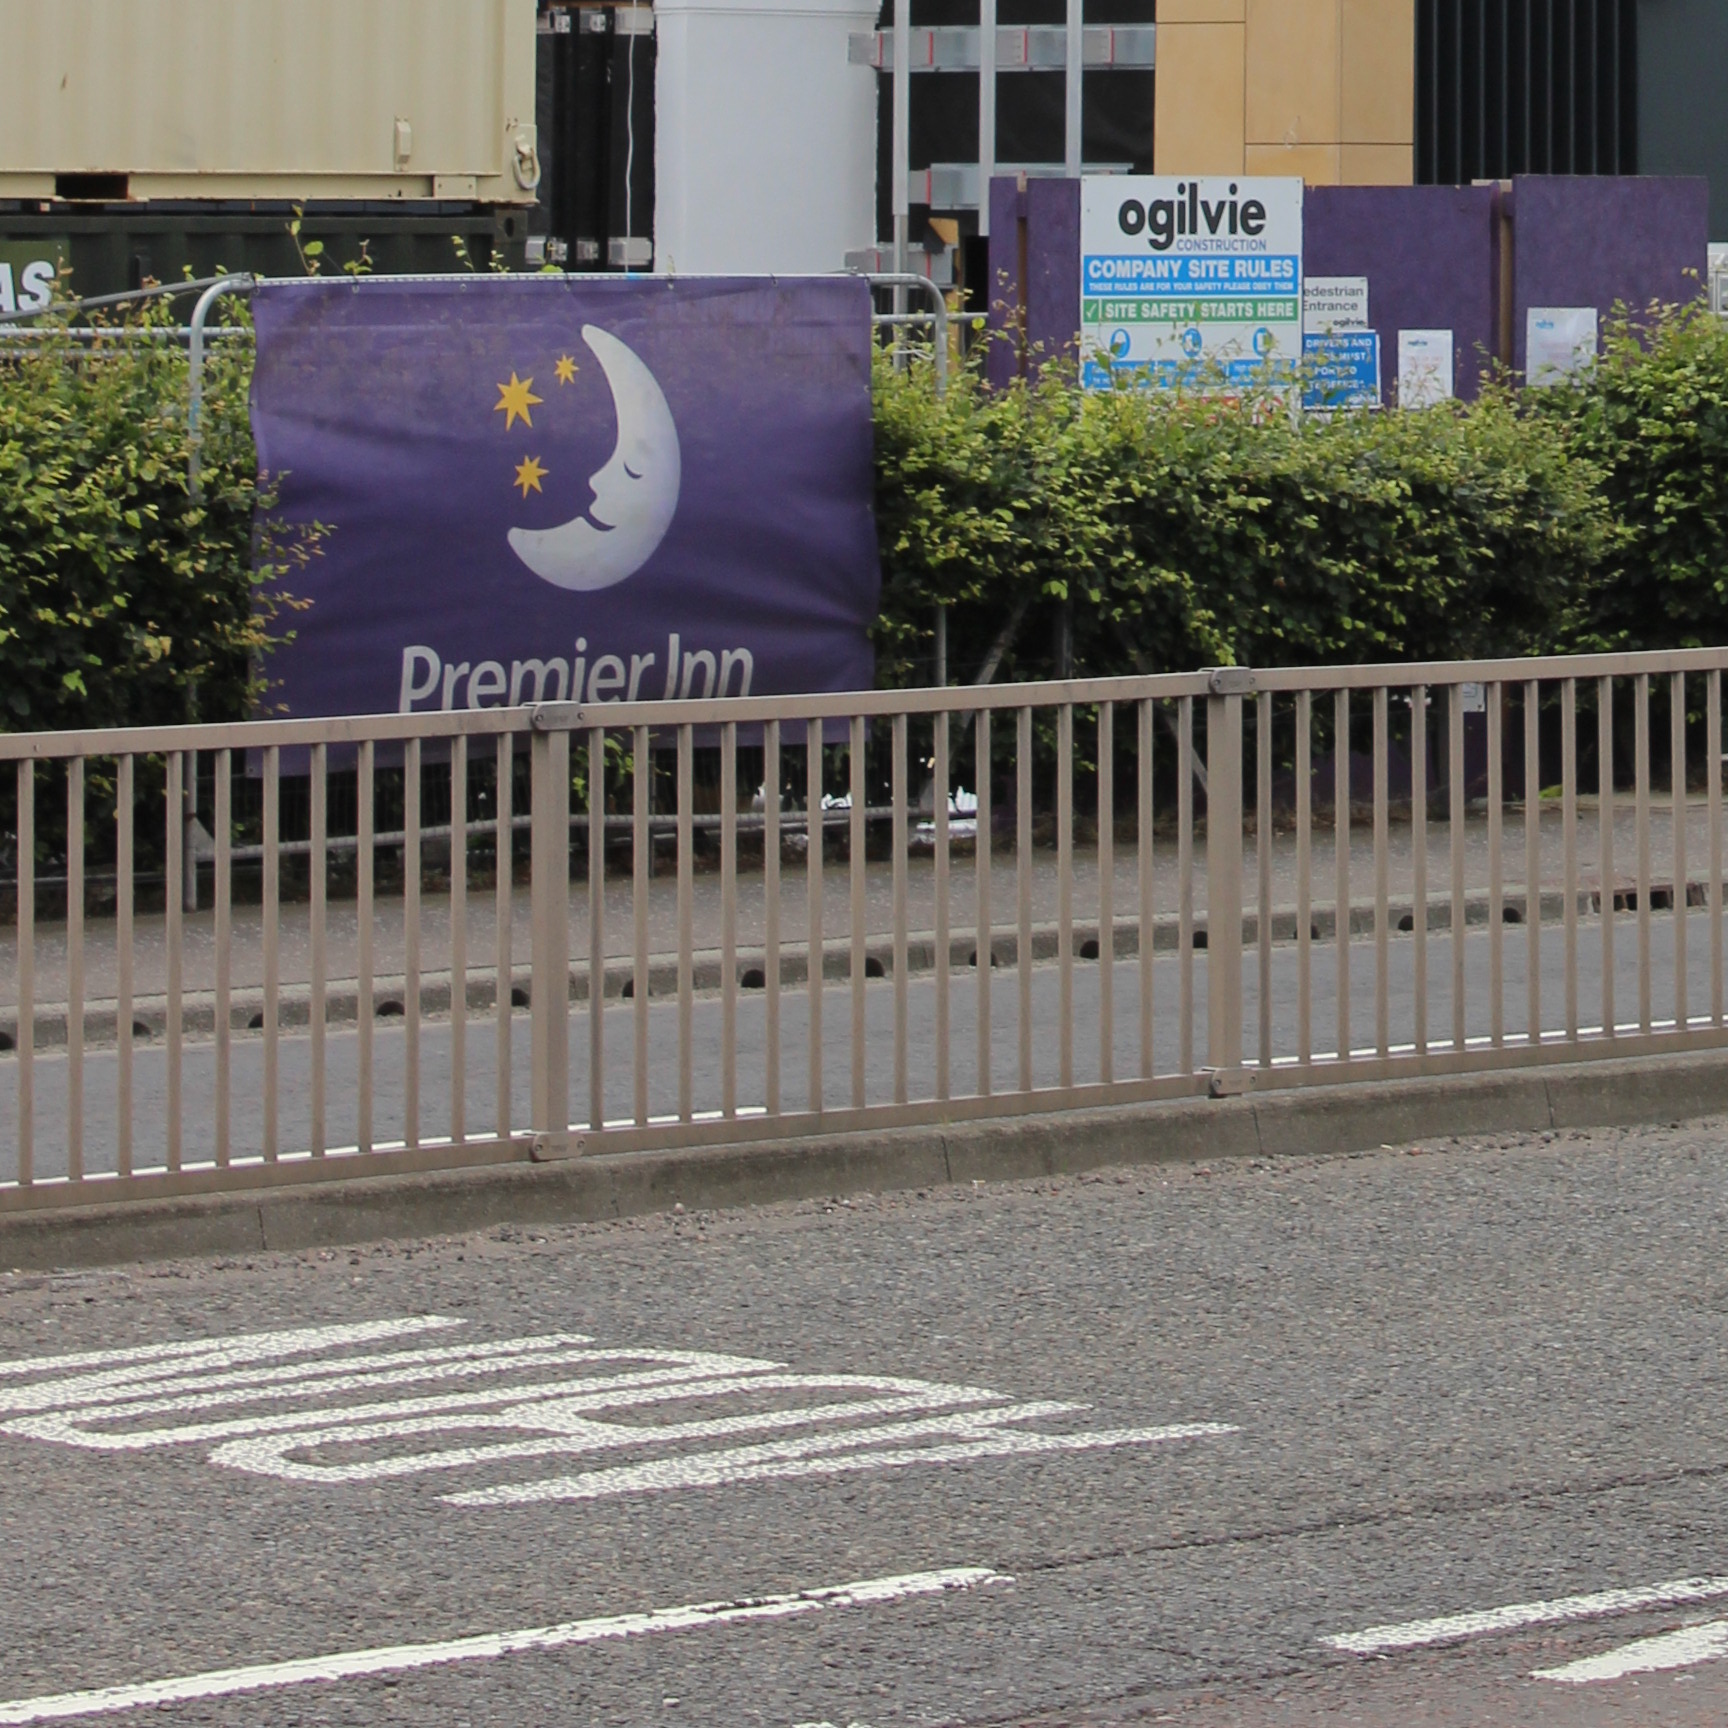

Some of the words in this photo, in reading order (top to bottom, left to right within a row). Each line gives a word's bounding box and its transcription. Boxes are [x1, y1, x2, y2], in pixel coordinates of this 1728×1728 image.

[1118, 182, 1266, 251] ogilvie
[1177, 239, 1266, 251] CONSTRUCTION
[1089, 260, 1181, 278] COMPANY
[1189, 260, 1229, 278] SITE
[1235, 260, 1294, 278] RULES
[1156, 282, 1172, 291] FOR
[1173, 282, 1192, 291] YOUR
[1195, 282, 1222, 291] SAFETY
[1304, 286, 1363, 296] edestrian
[1105, 304, 1137, 318] SITE
[1141, 303, 1195, 318] SAFETY
[1201, 303, 1253, 317] STARTS
[1258, 303, 1293, 317] HERE
[399, 636, 655, 713] Premier
[664, 633, 754, 700] Inn
